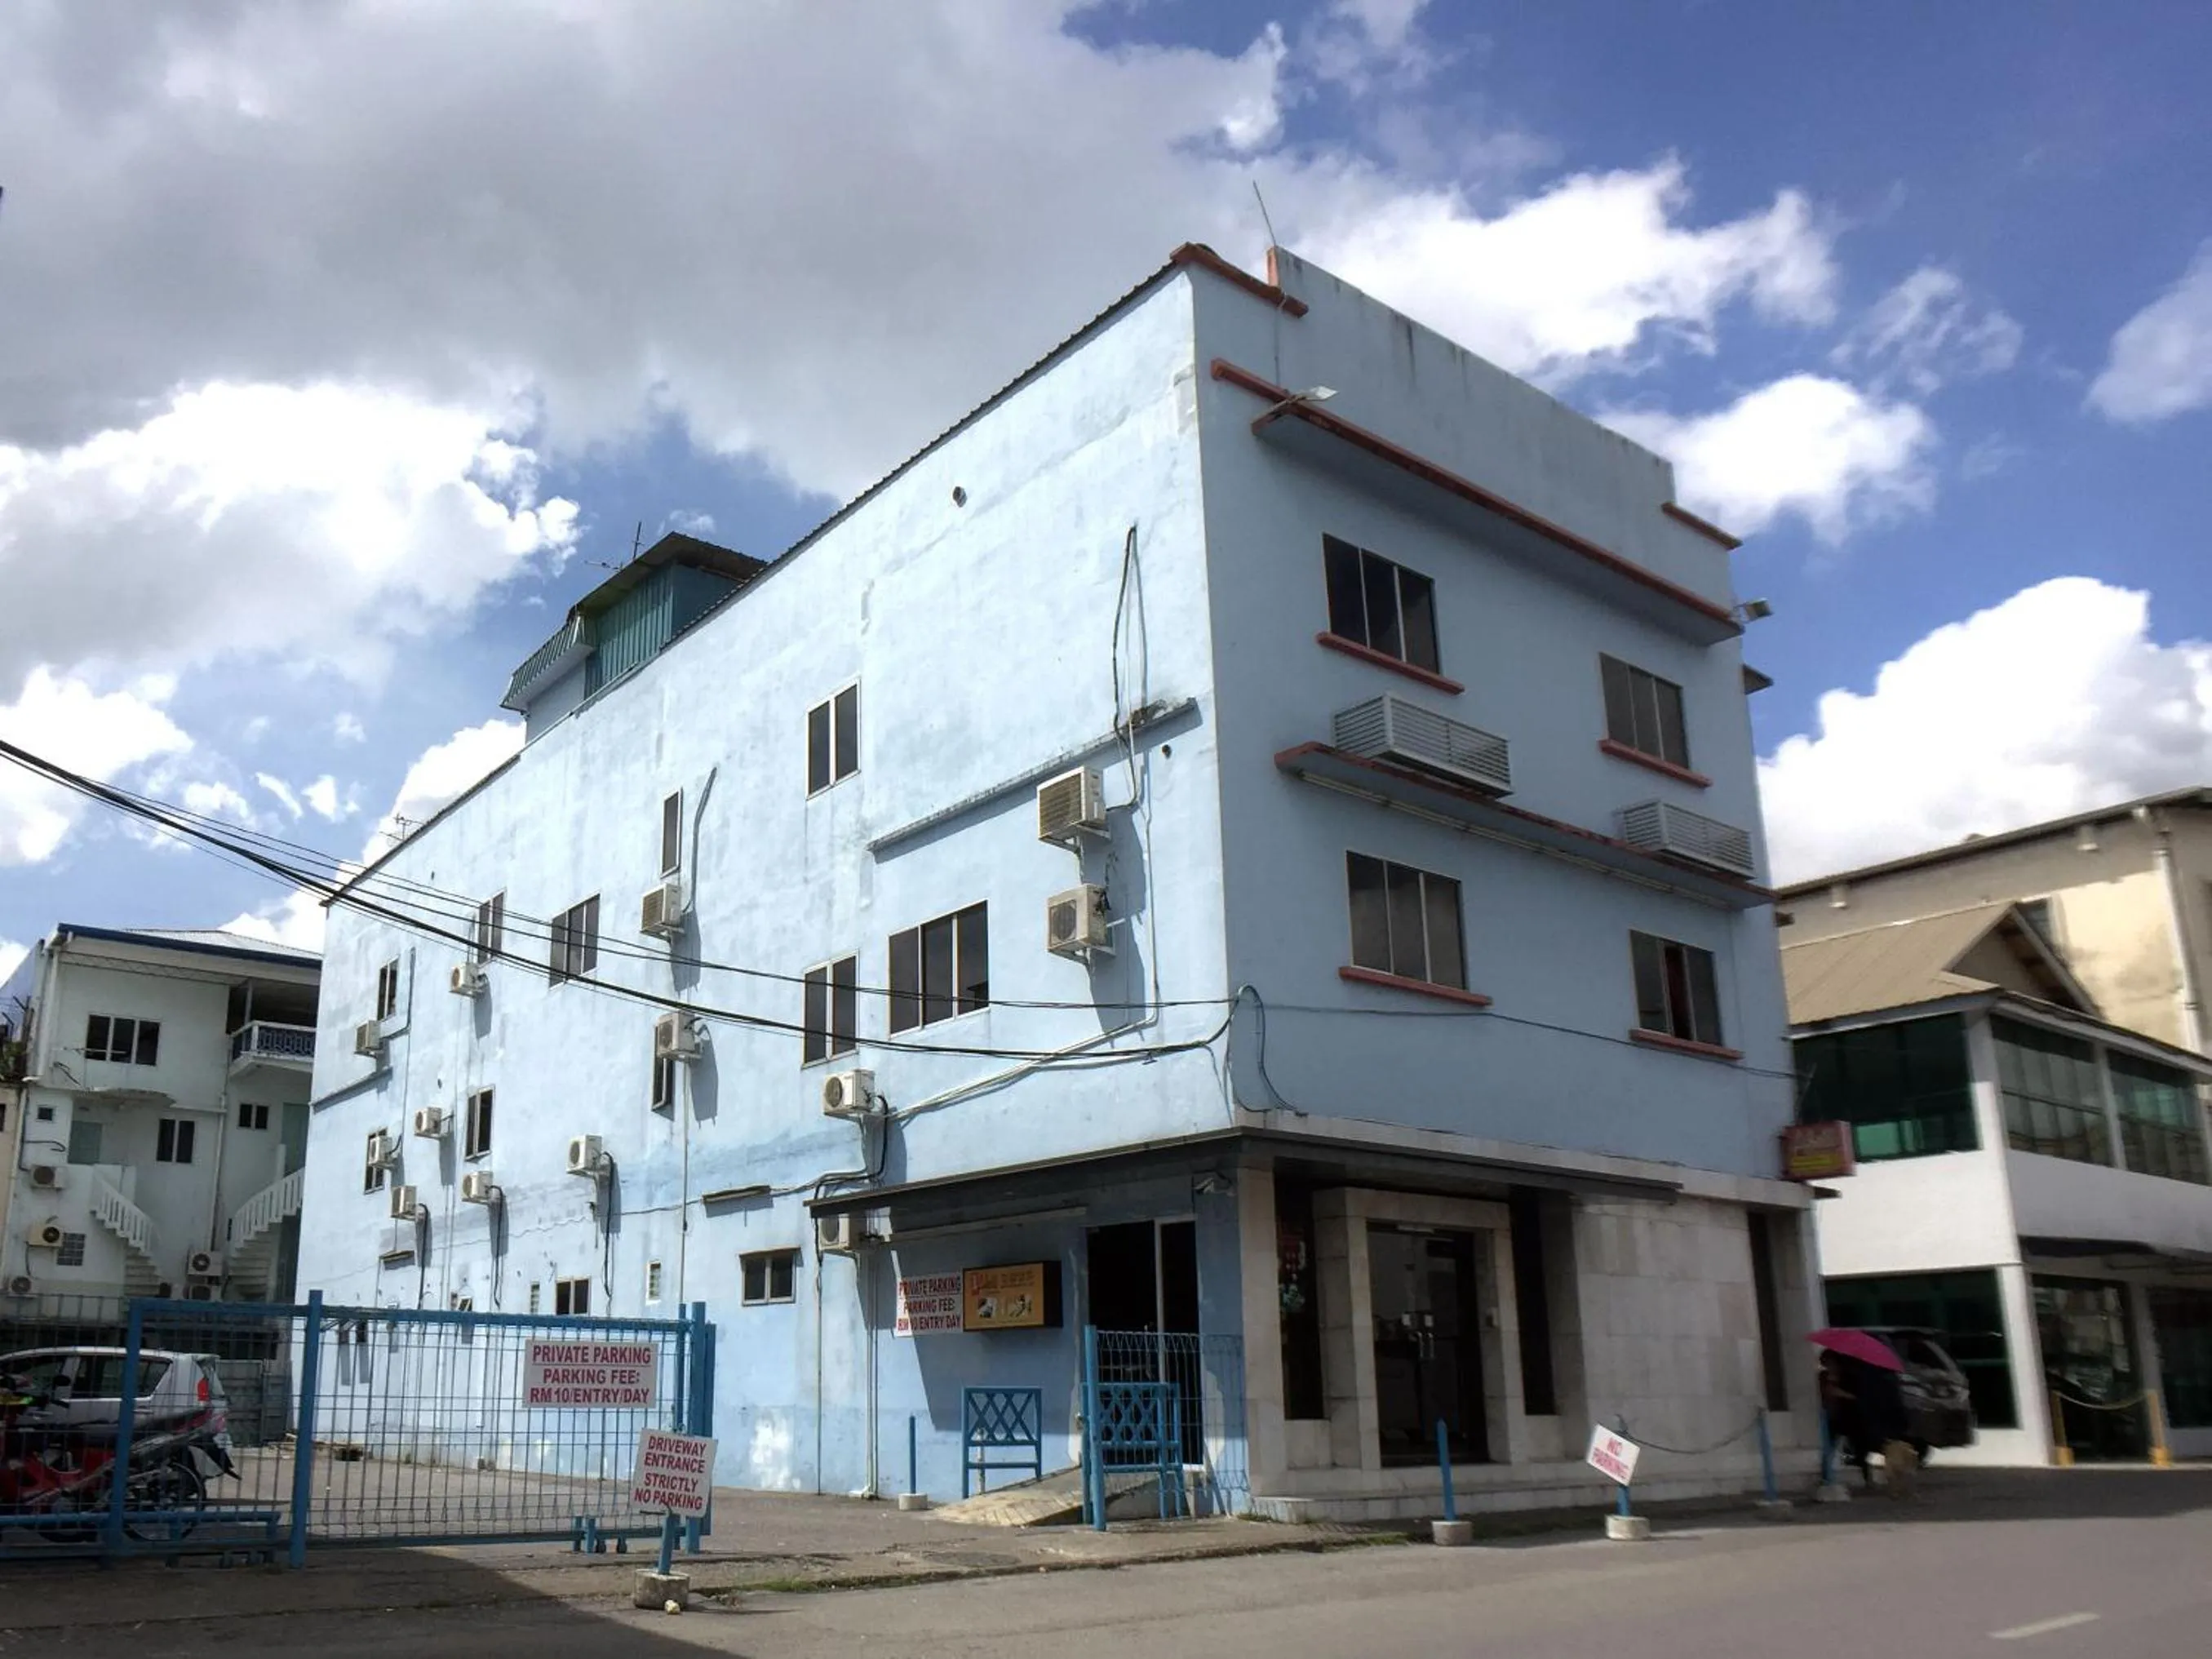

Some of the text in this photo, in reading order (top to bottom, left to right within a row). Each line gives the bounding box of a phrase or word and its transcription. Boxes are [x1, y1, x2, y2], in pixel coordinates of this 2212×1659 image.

[900, 1279, 928, 1296] PRIVATE
[929, 1275, 961, 1293] PARKING
[904, 1298, 937, 1314] PARKING
[533, 1344, 651, 1364] PRIVATE PARKING
[543, 1368, 640, 1384] PARKING FEE:
[648, 1436, 707, 1457] DRIVEWAY
[1607, 1438, 1623, 1457] NO
[644, 1453, 705, 1473] ENTRANCE
[645, 1472, 698, 1493] STRICTLY
[634, 1488, 703, 1510] NO PARKING
